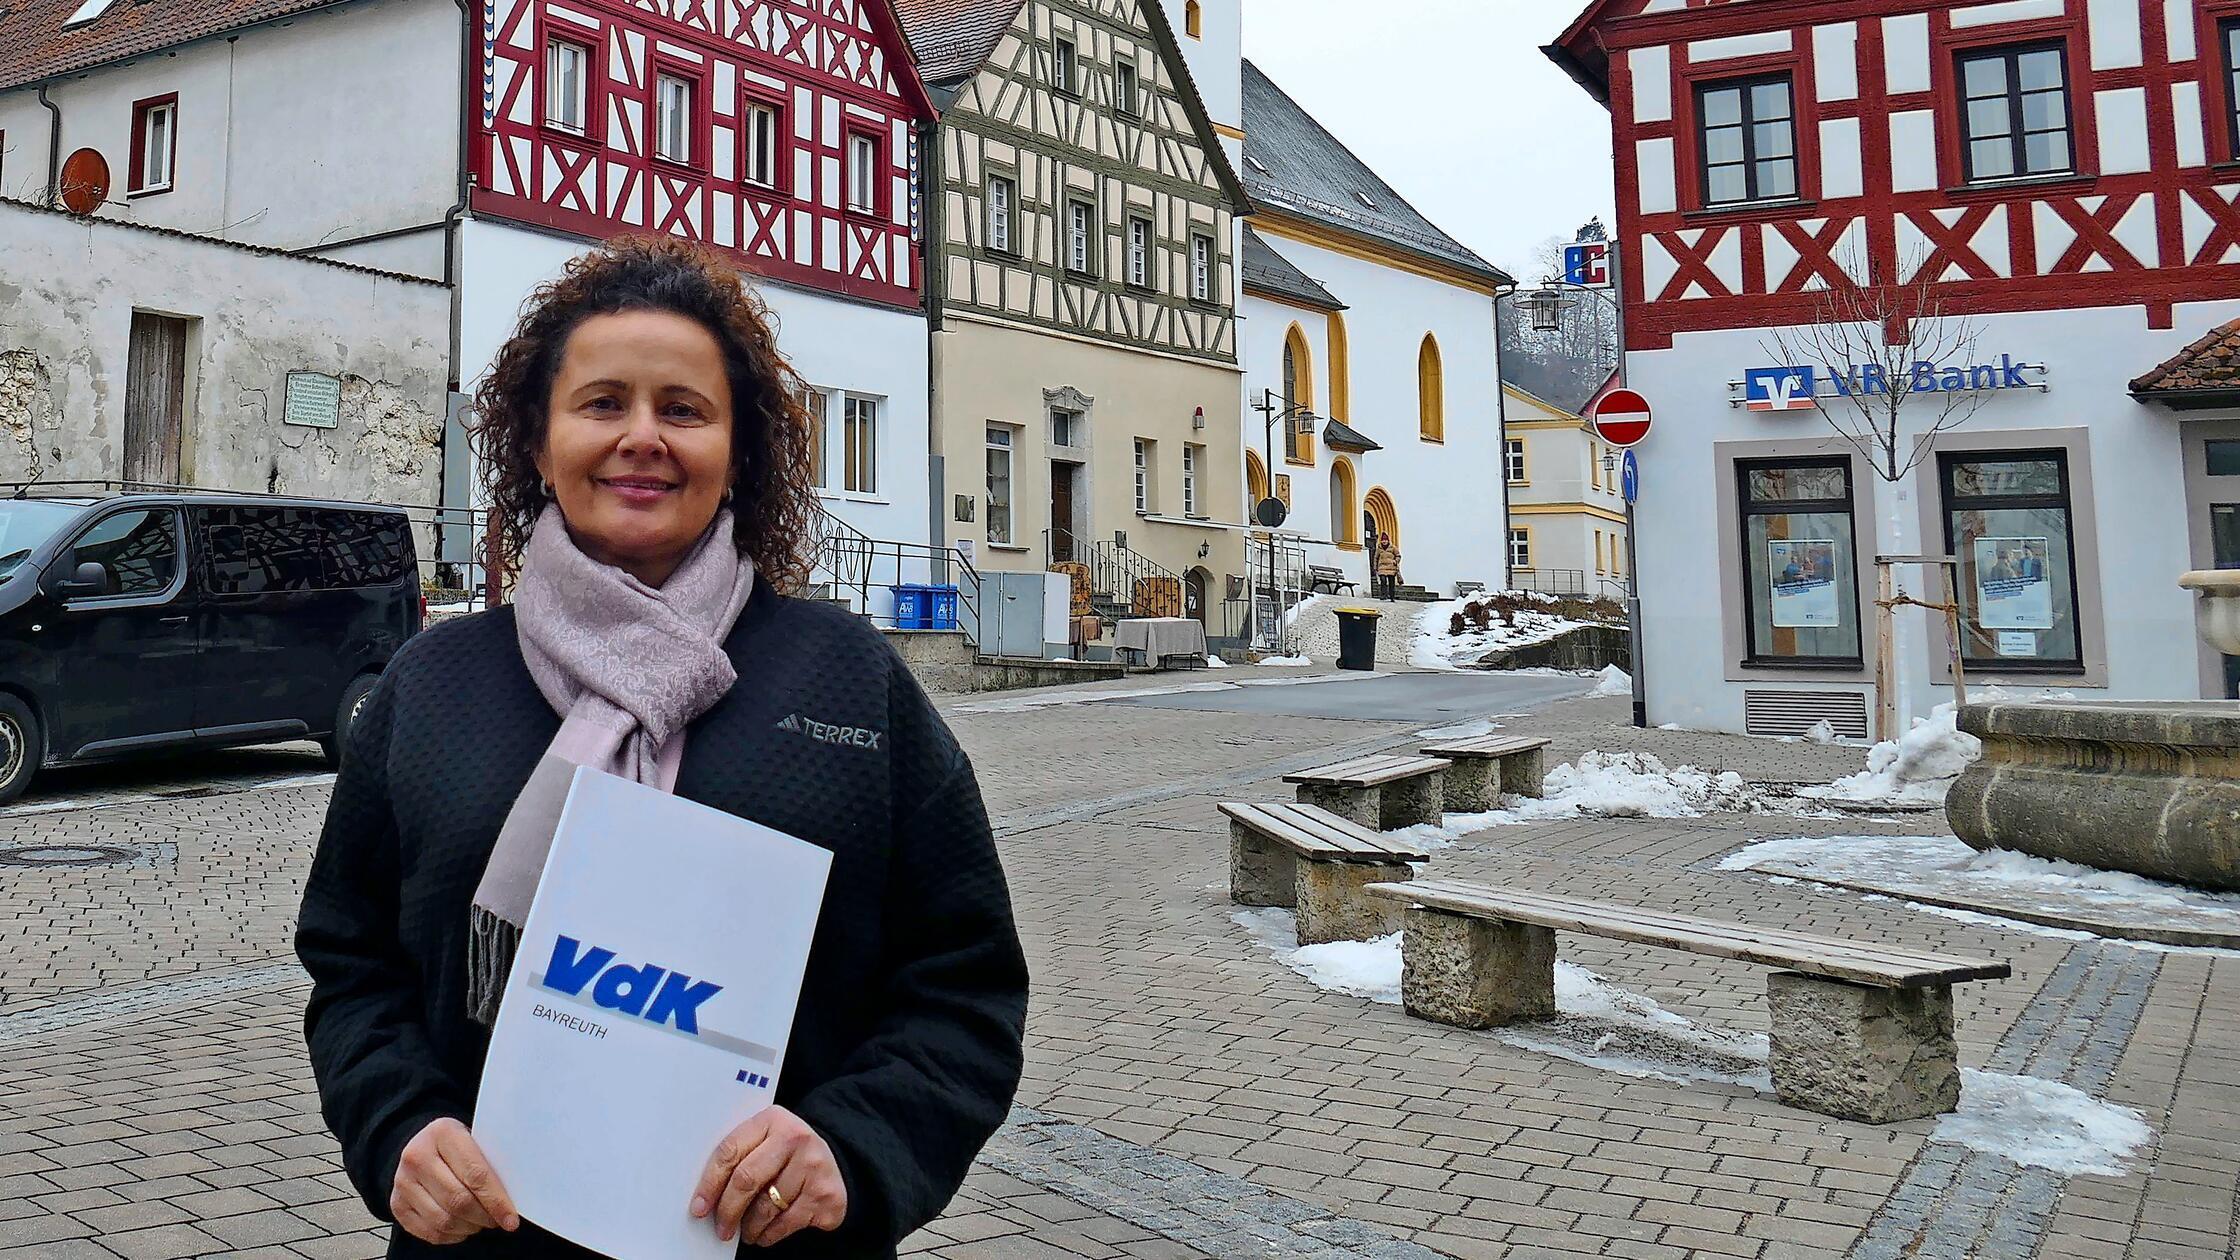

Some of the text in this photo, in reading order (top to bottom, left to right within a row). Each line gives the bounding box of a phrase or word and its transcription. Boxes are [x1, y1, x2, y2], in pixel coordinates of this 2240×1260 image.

[1827, 353, 2029, 396] VR Bank
[803, 717, 882, 750] TERREX
[543, 934, 724, 1036] VdK
[533, 1004, 608, 1039] BAYREUTH
